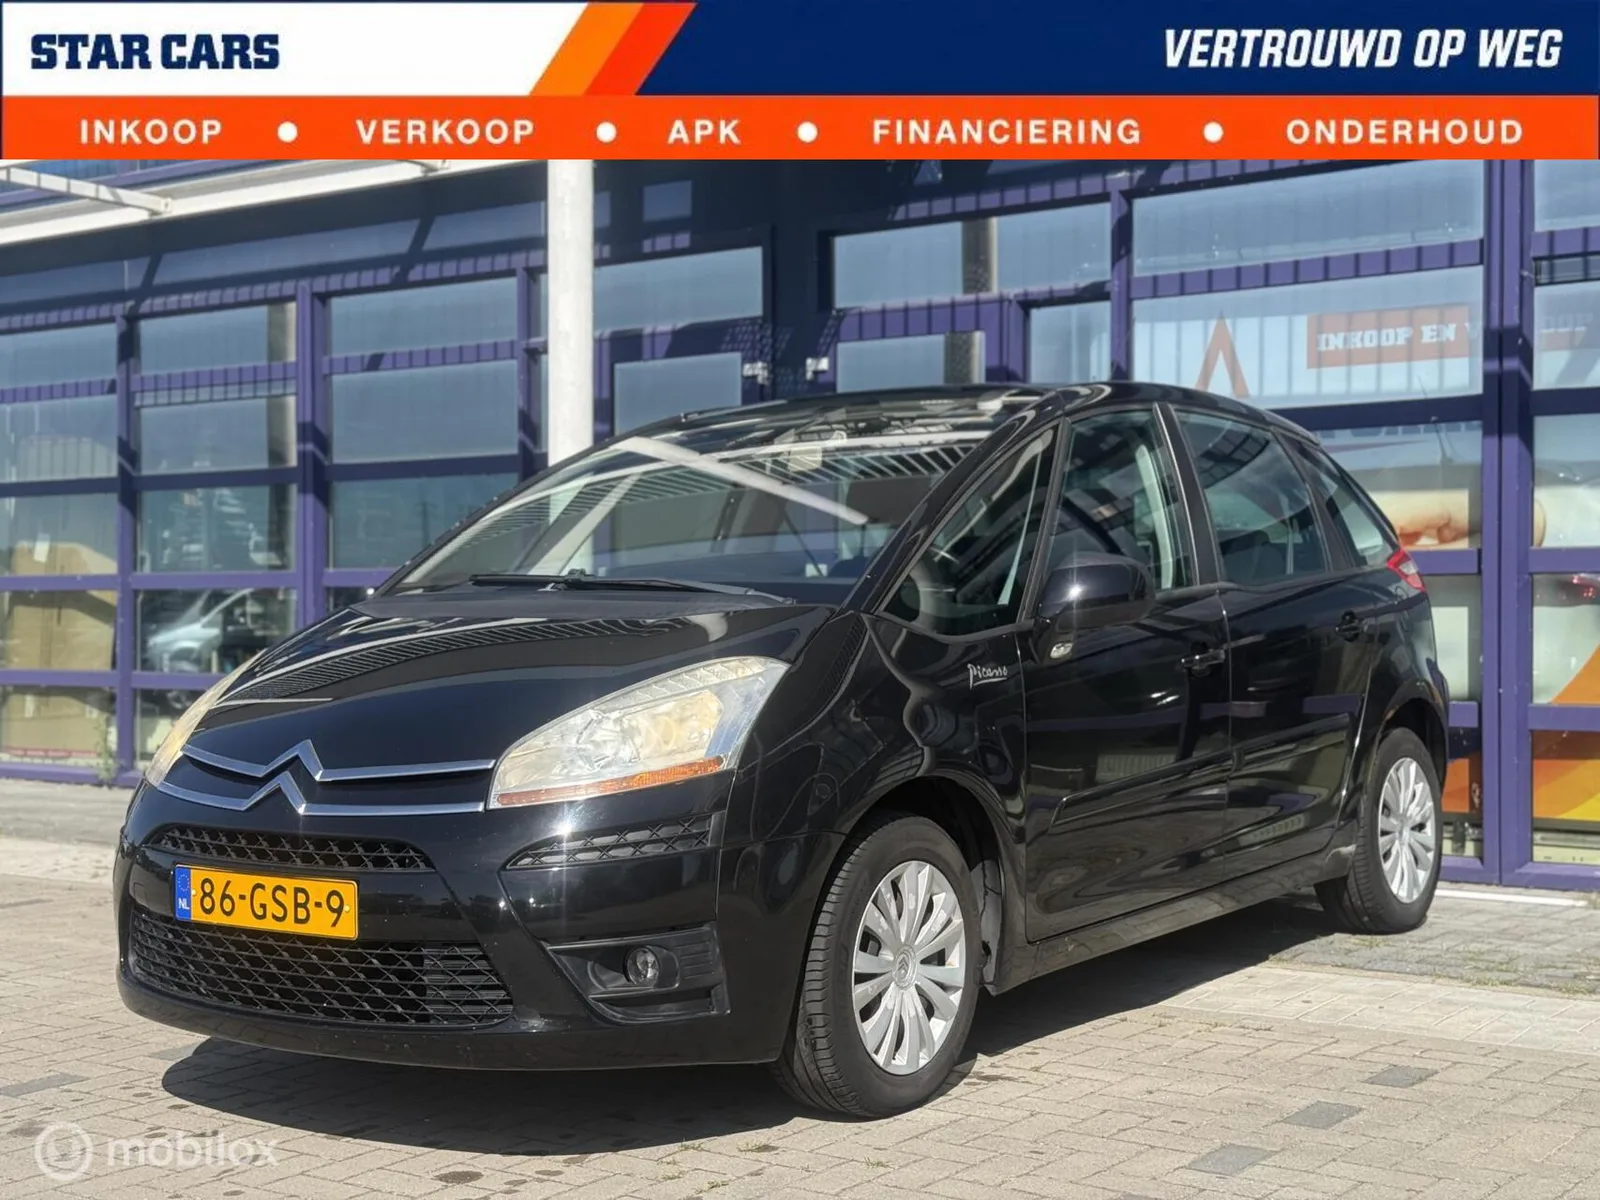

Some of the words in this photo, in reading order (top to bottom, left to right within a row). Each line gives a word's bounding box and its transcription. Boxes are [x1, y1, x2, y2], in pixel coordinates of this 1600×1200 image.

[1316, 325, 1413, 352] INKOOP
[1420, 322, 1457, 344] EN
[178, 897, 191, 910] NL
[200, 877, 344, 928] 86-GSB-9
